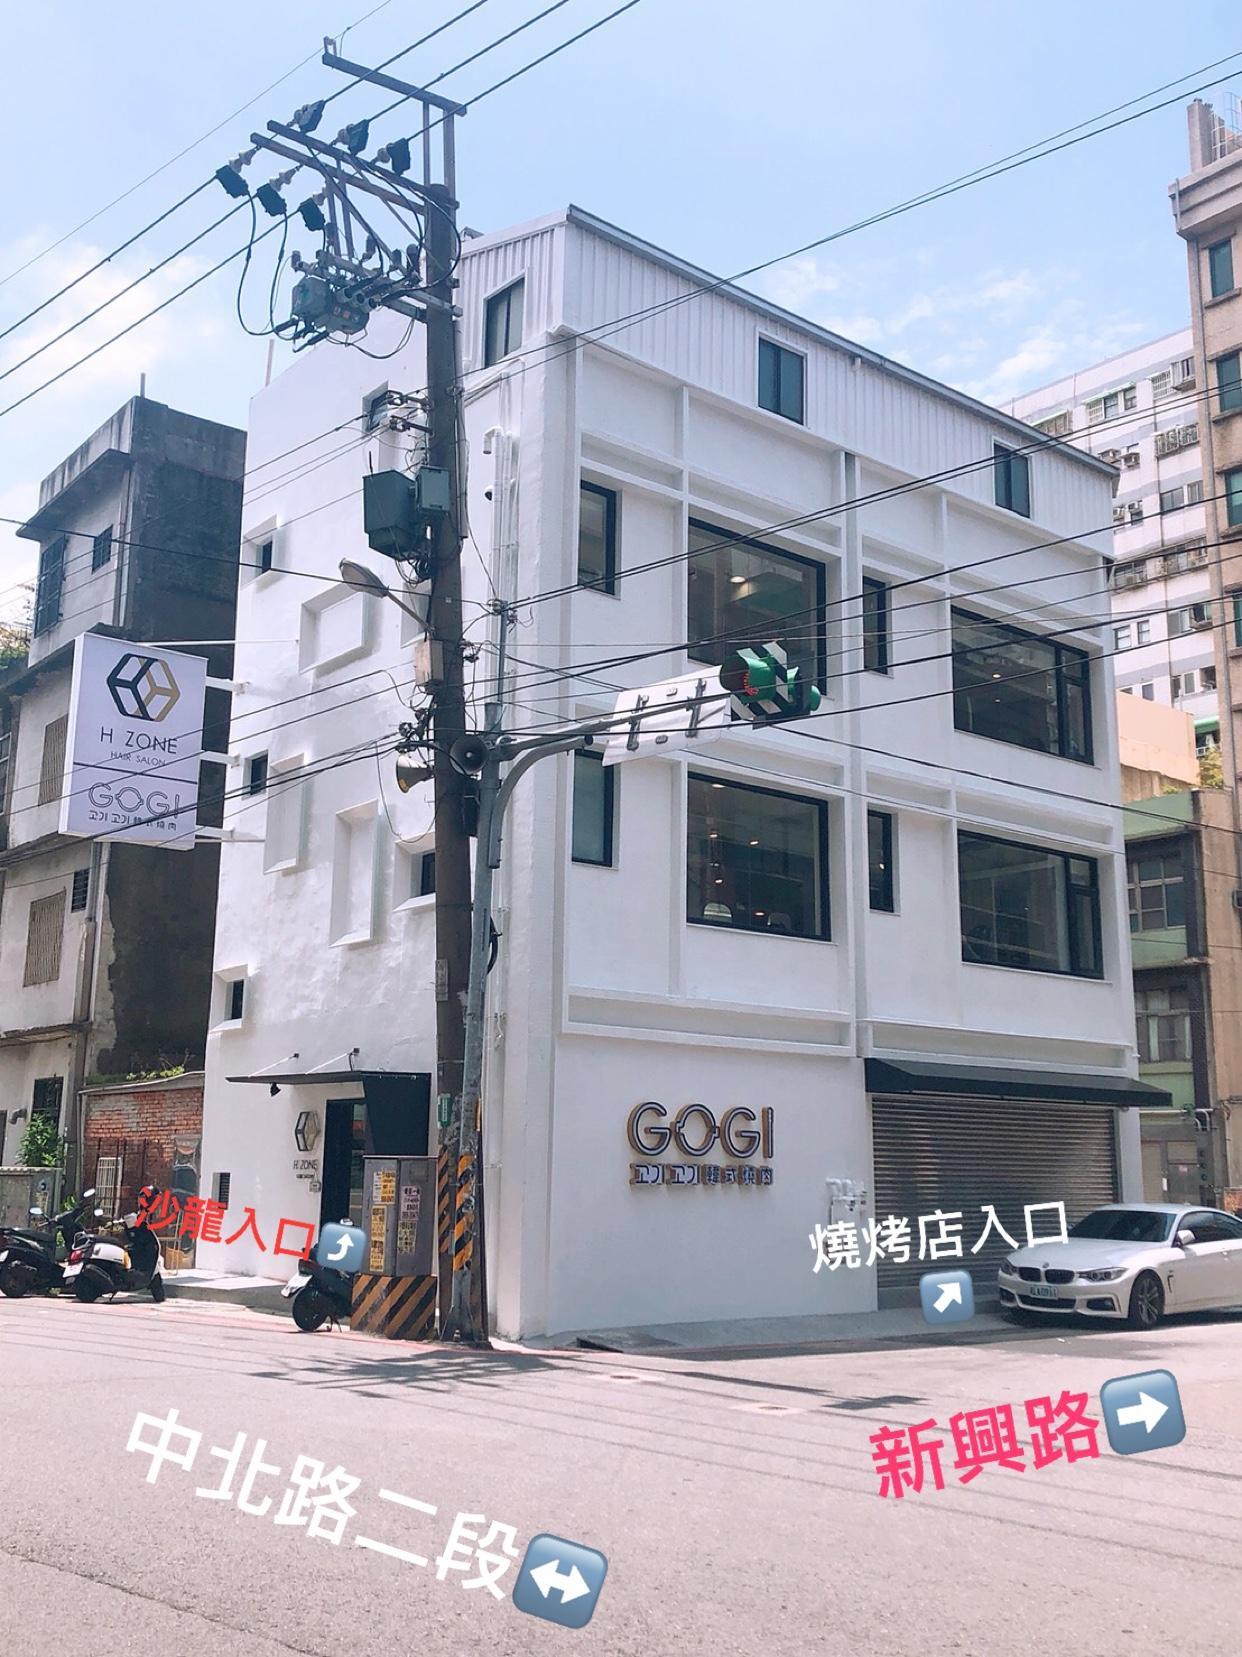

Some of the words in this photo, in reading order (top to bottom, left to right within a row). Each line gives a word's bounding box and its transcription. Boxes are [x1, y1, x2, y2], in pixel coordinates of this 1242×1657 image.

[100, 726, 113, 744] H
[125, 730, 177, 754] ZONE
[110, 751, 131, 762] HAIR
[135, 755, 166, 767] SALON
[88, 782, 180, 820] GOGI
[628, 1101, 774, 1158] GOGI
[300, 1159, 319, 1170] ZONE
